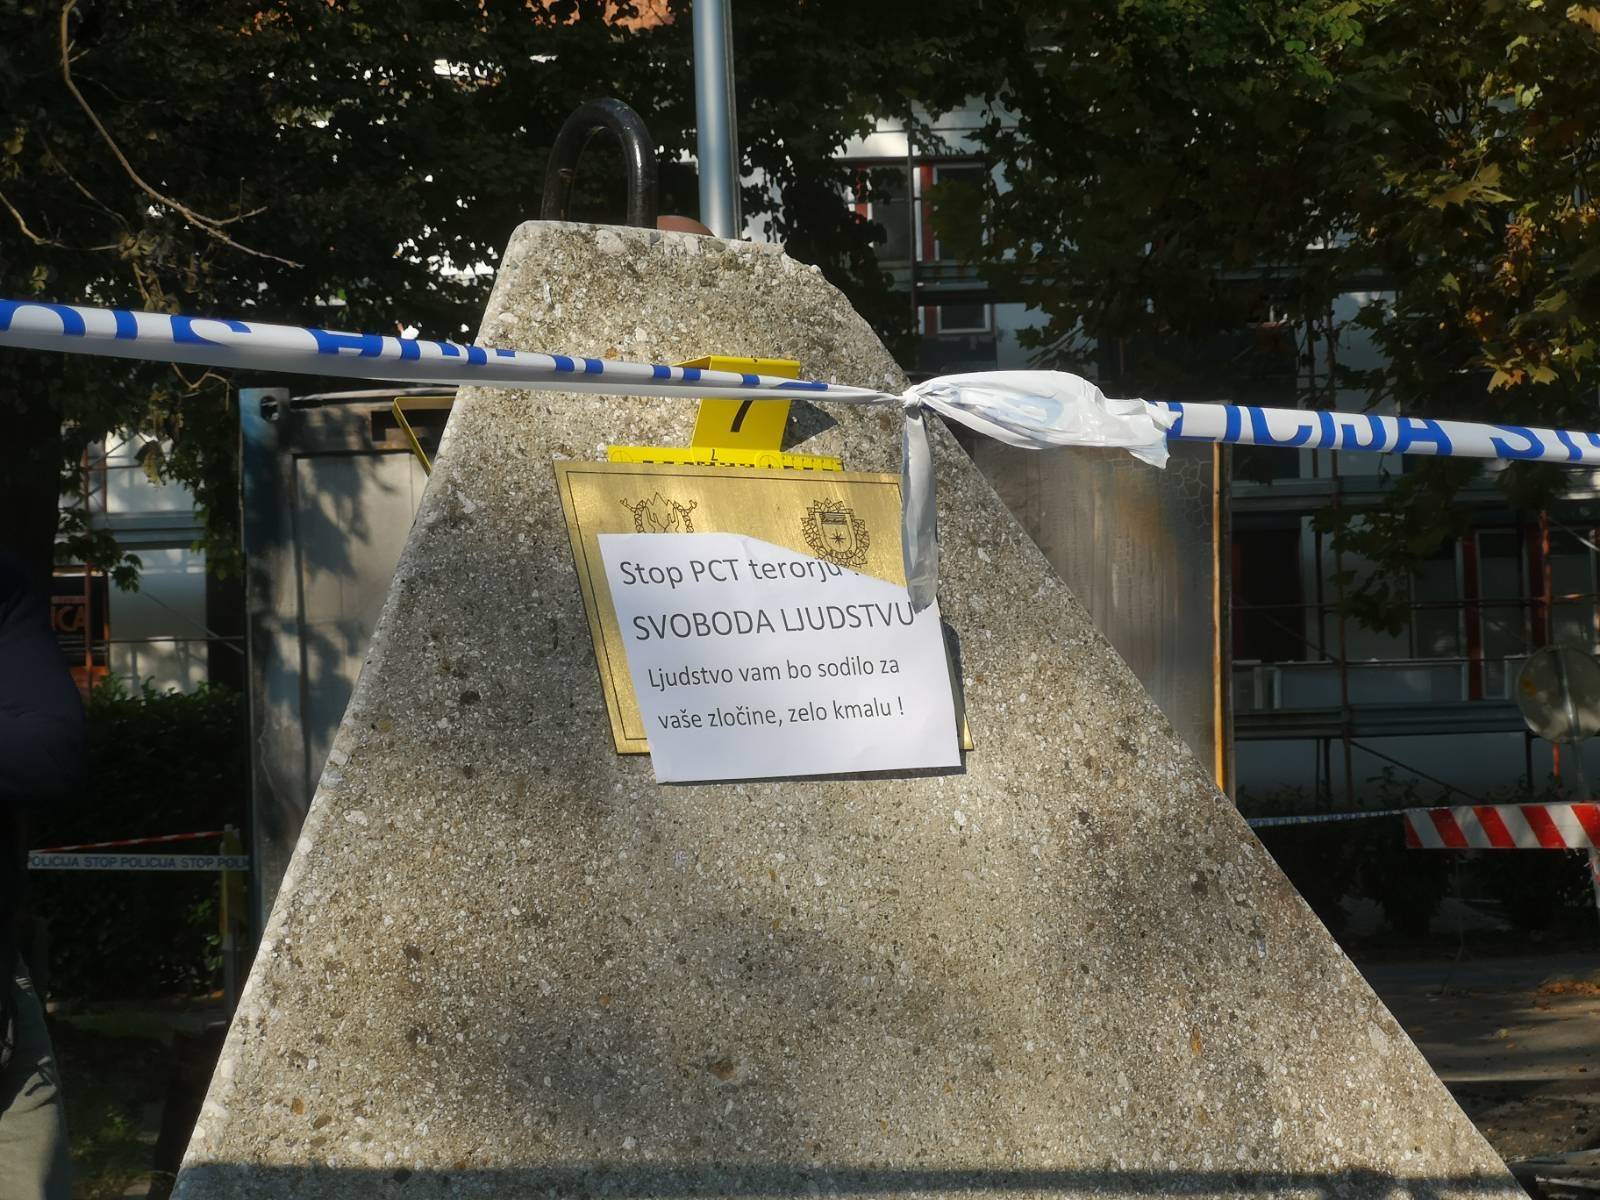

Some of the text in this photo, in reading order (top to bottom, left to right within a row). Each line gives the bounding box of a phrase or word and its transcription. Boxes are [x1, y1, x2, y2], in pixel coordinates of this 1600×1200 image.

[620, 559, 843, 589] Stop PCT terorju
[632, 602, 914, 641] SVOBODA LJUDSTVU
[648, 655, 900, 692] Ljudstvo vam bo sodilo za
[658, 696, 905, 729] vaše zločine, zelo kmalu !
[83, 855, 119, 868] STOP
[120, 856, 177, 869] POLICIJA
[181, 857, 214, 869] STOP
